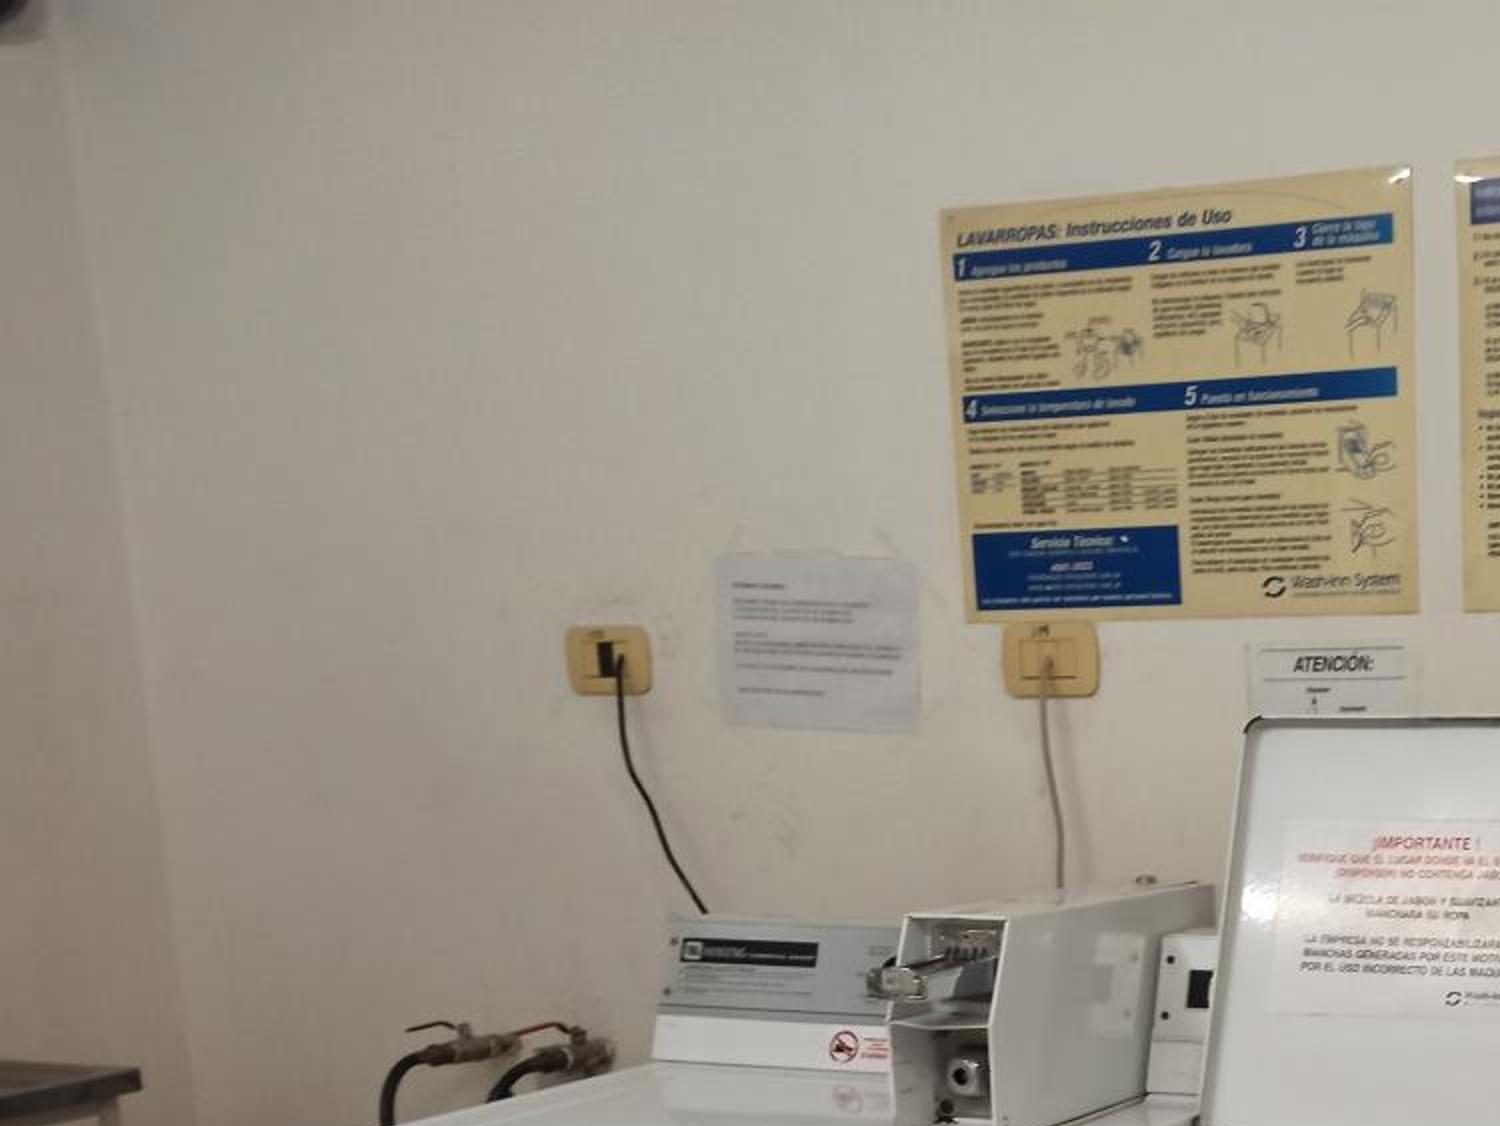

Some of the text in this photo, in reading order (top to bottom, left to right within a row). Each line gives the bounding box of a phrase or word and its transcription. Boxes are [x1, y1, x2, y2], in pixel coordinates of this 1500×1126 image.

[1066, 215, 1171, 238] Instrucciones
[1177, 211, 1197, 228] de
[1201, 209, 1232, 226] Uso
[1294, 226, 1308, 249] 3
[1148, 240, 1162, 261] 2
[1184, 385, 1198, 406] 5
